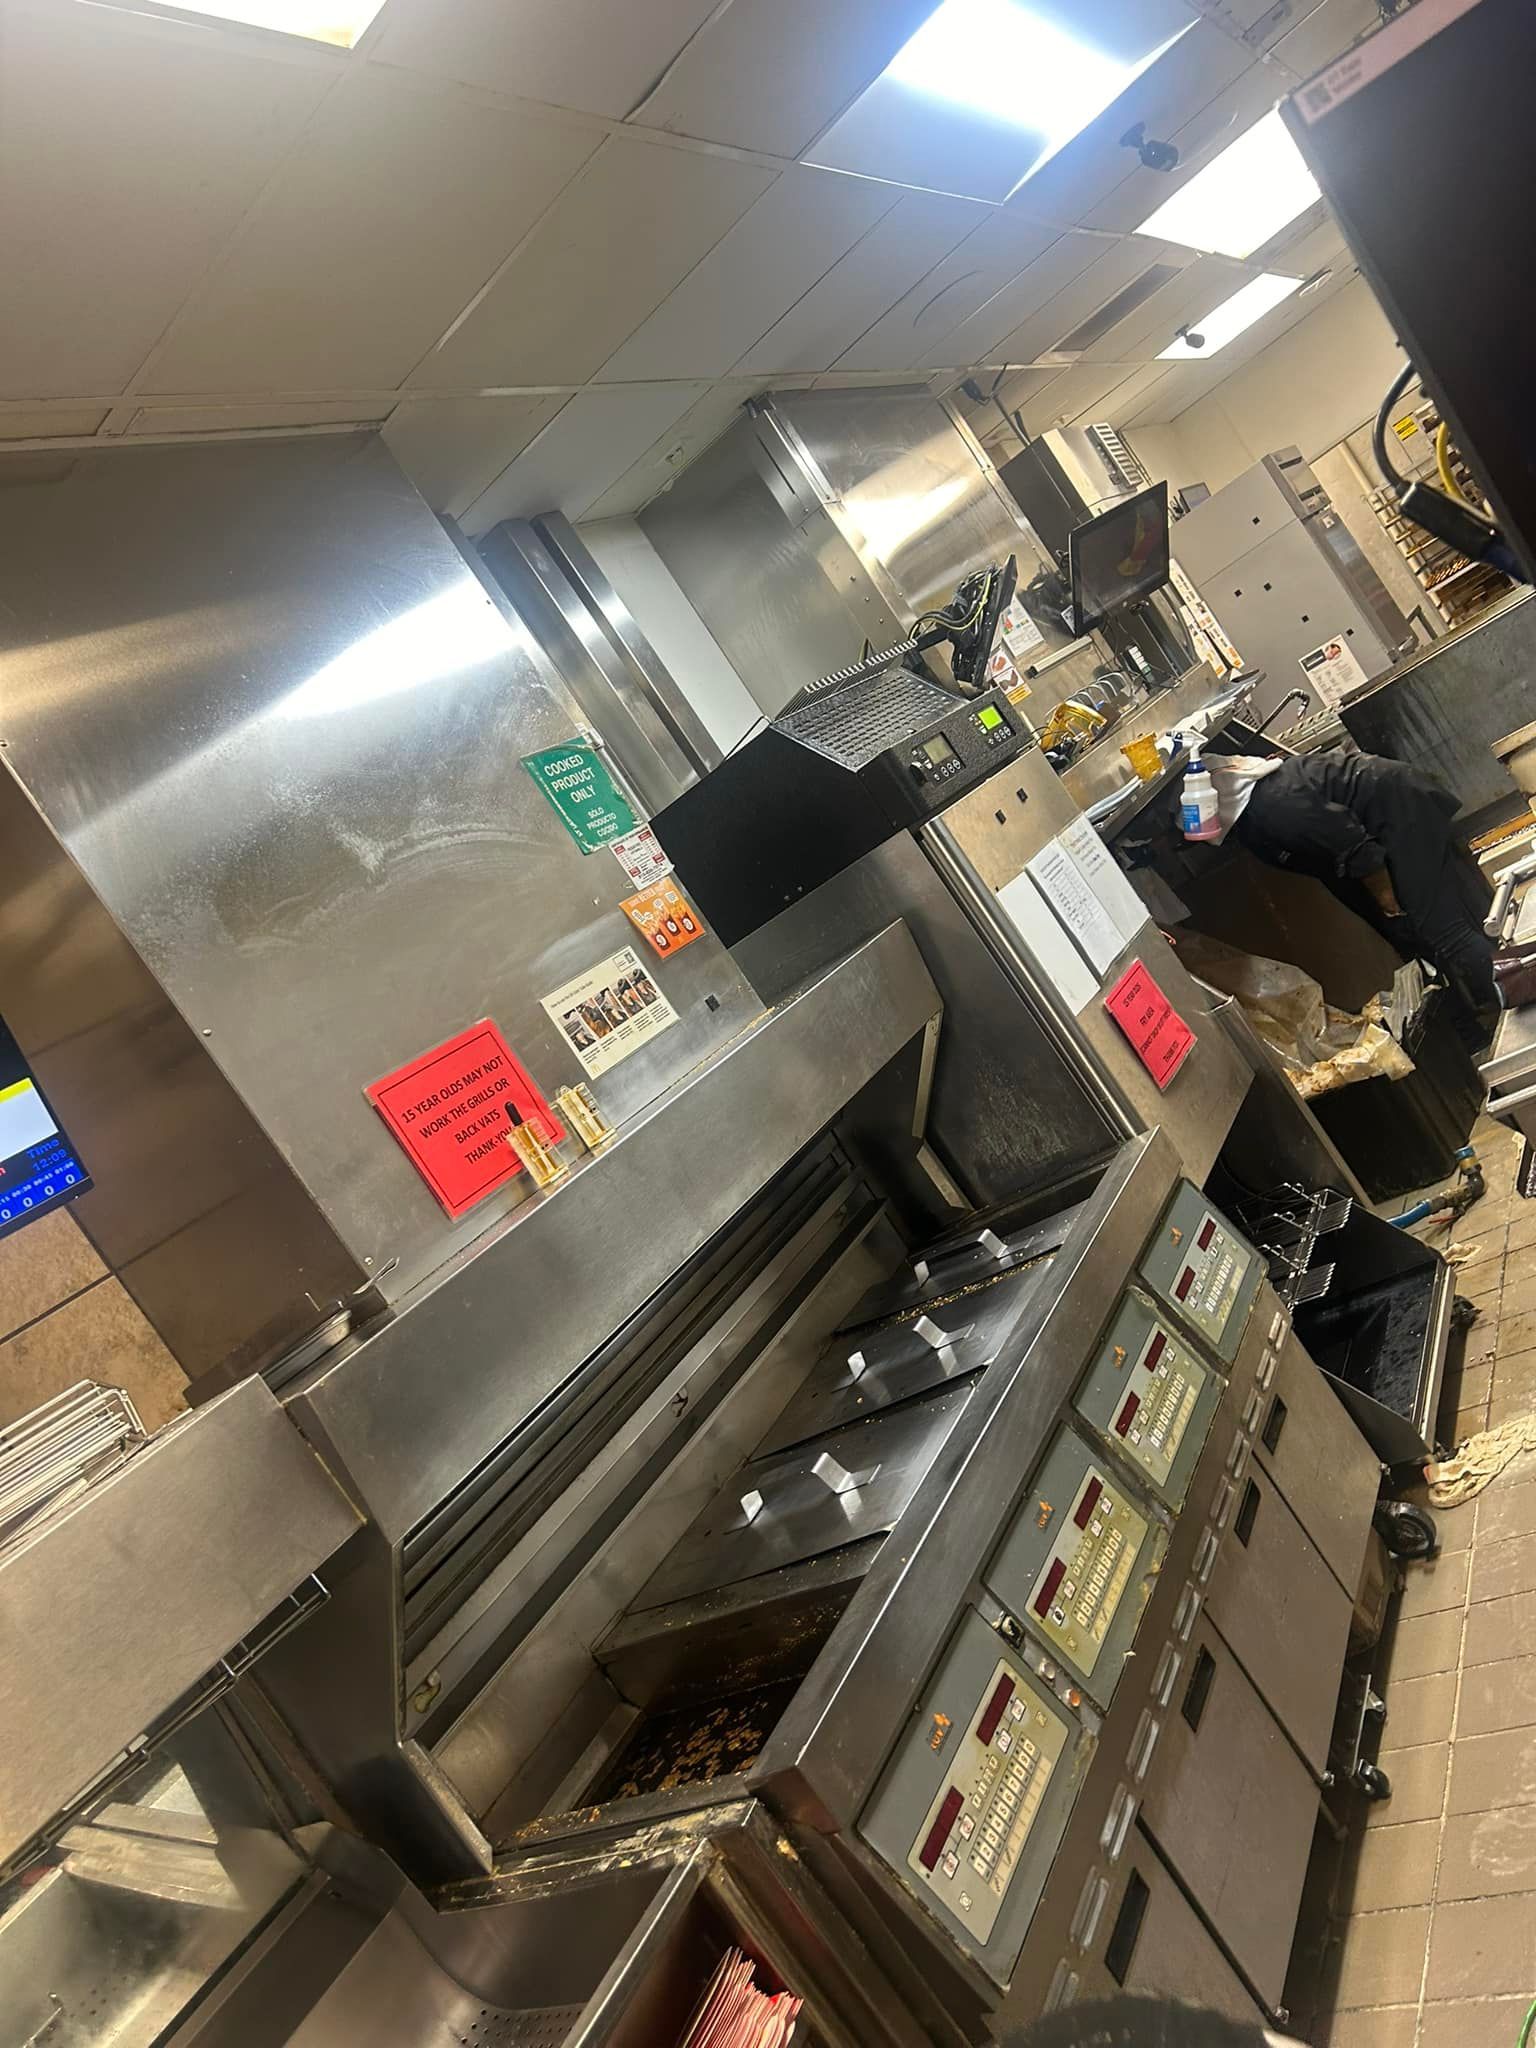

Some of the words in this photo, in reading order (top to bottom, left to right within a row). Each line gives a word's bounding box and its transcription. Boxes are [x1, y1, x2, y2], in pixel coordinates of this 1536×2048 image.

[544, 754, 584, 777] COOKED
[551, 767, 596, 792] PRODUCT
[571, 784, 596, 804] ONLY
[402, 1106, 416, 1124] 15
[416, 1094, 440, 1116] YEAR
[440, 1080, 464, 1100] OLDS
[463, 1067, 484, 1086] MAY
[482, 1056, 504, 1075] NOT
[420, 1113, 452, 1140] WORK
[450, 1103, 468, 1120] THE
[468, 1088, 496, 1110] GRILLS
[494, 1077, 510, 1094] OR
[454, 1122, 480, 1144] BACK
[478, 1109, 500, 1128] VATS
[27, 1139, 59, 1158] Time
[1, 1209, 11, 1220] 0
[23, 1197, 33, 1208] 0
[44, 1185, 54, 1196] 0
[65, 1174, 75, 1184] 0
[982, 1847, 990, 1856] 2
[988, 1833, 996, 1842] 3
[994, 1819, 1000, 1827] 4
[999, 1805, 1008, 1814] 5
[1005, 1792, 1012, 1801] 6
[1010, 1780, 1018, 1788] 7
[1020, 1755, 1027, 1763] 9
